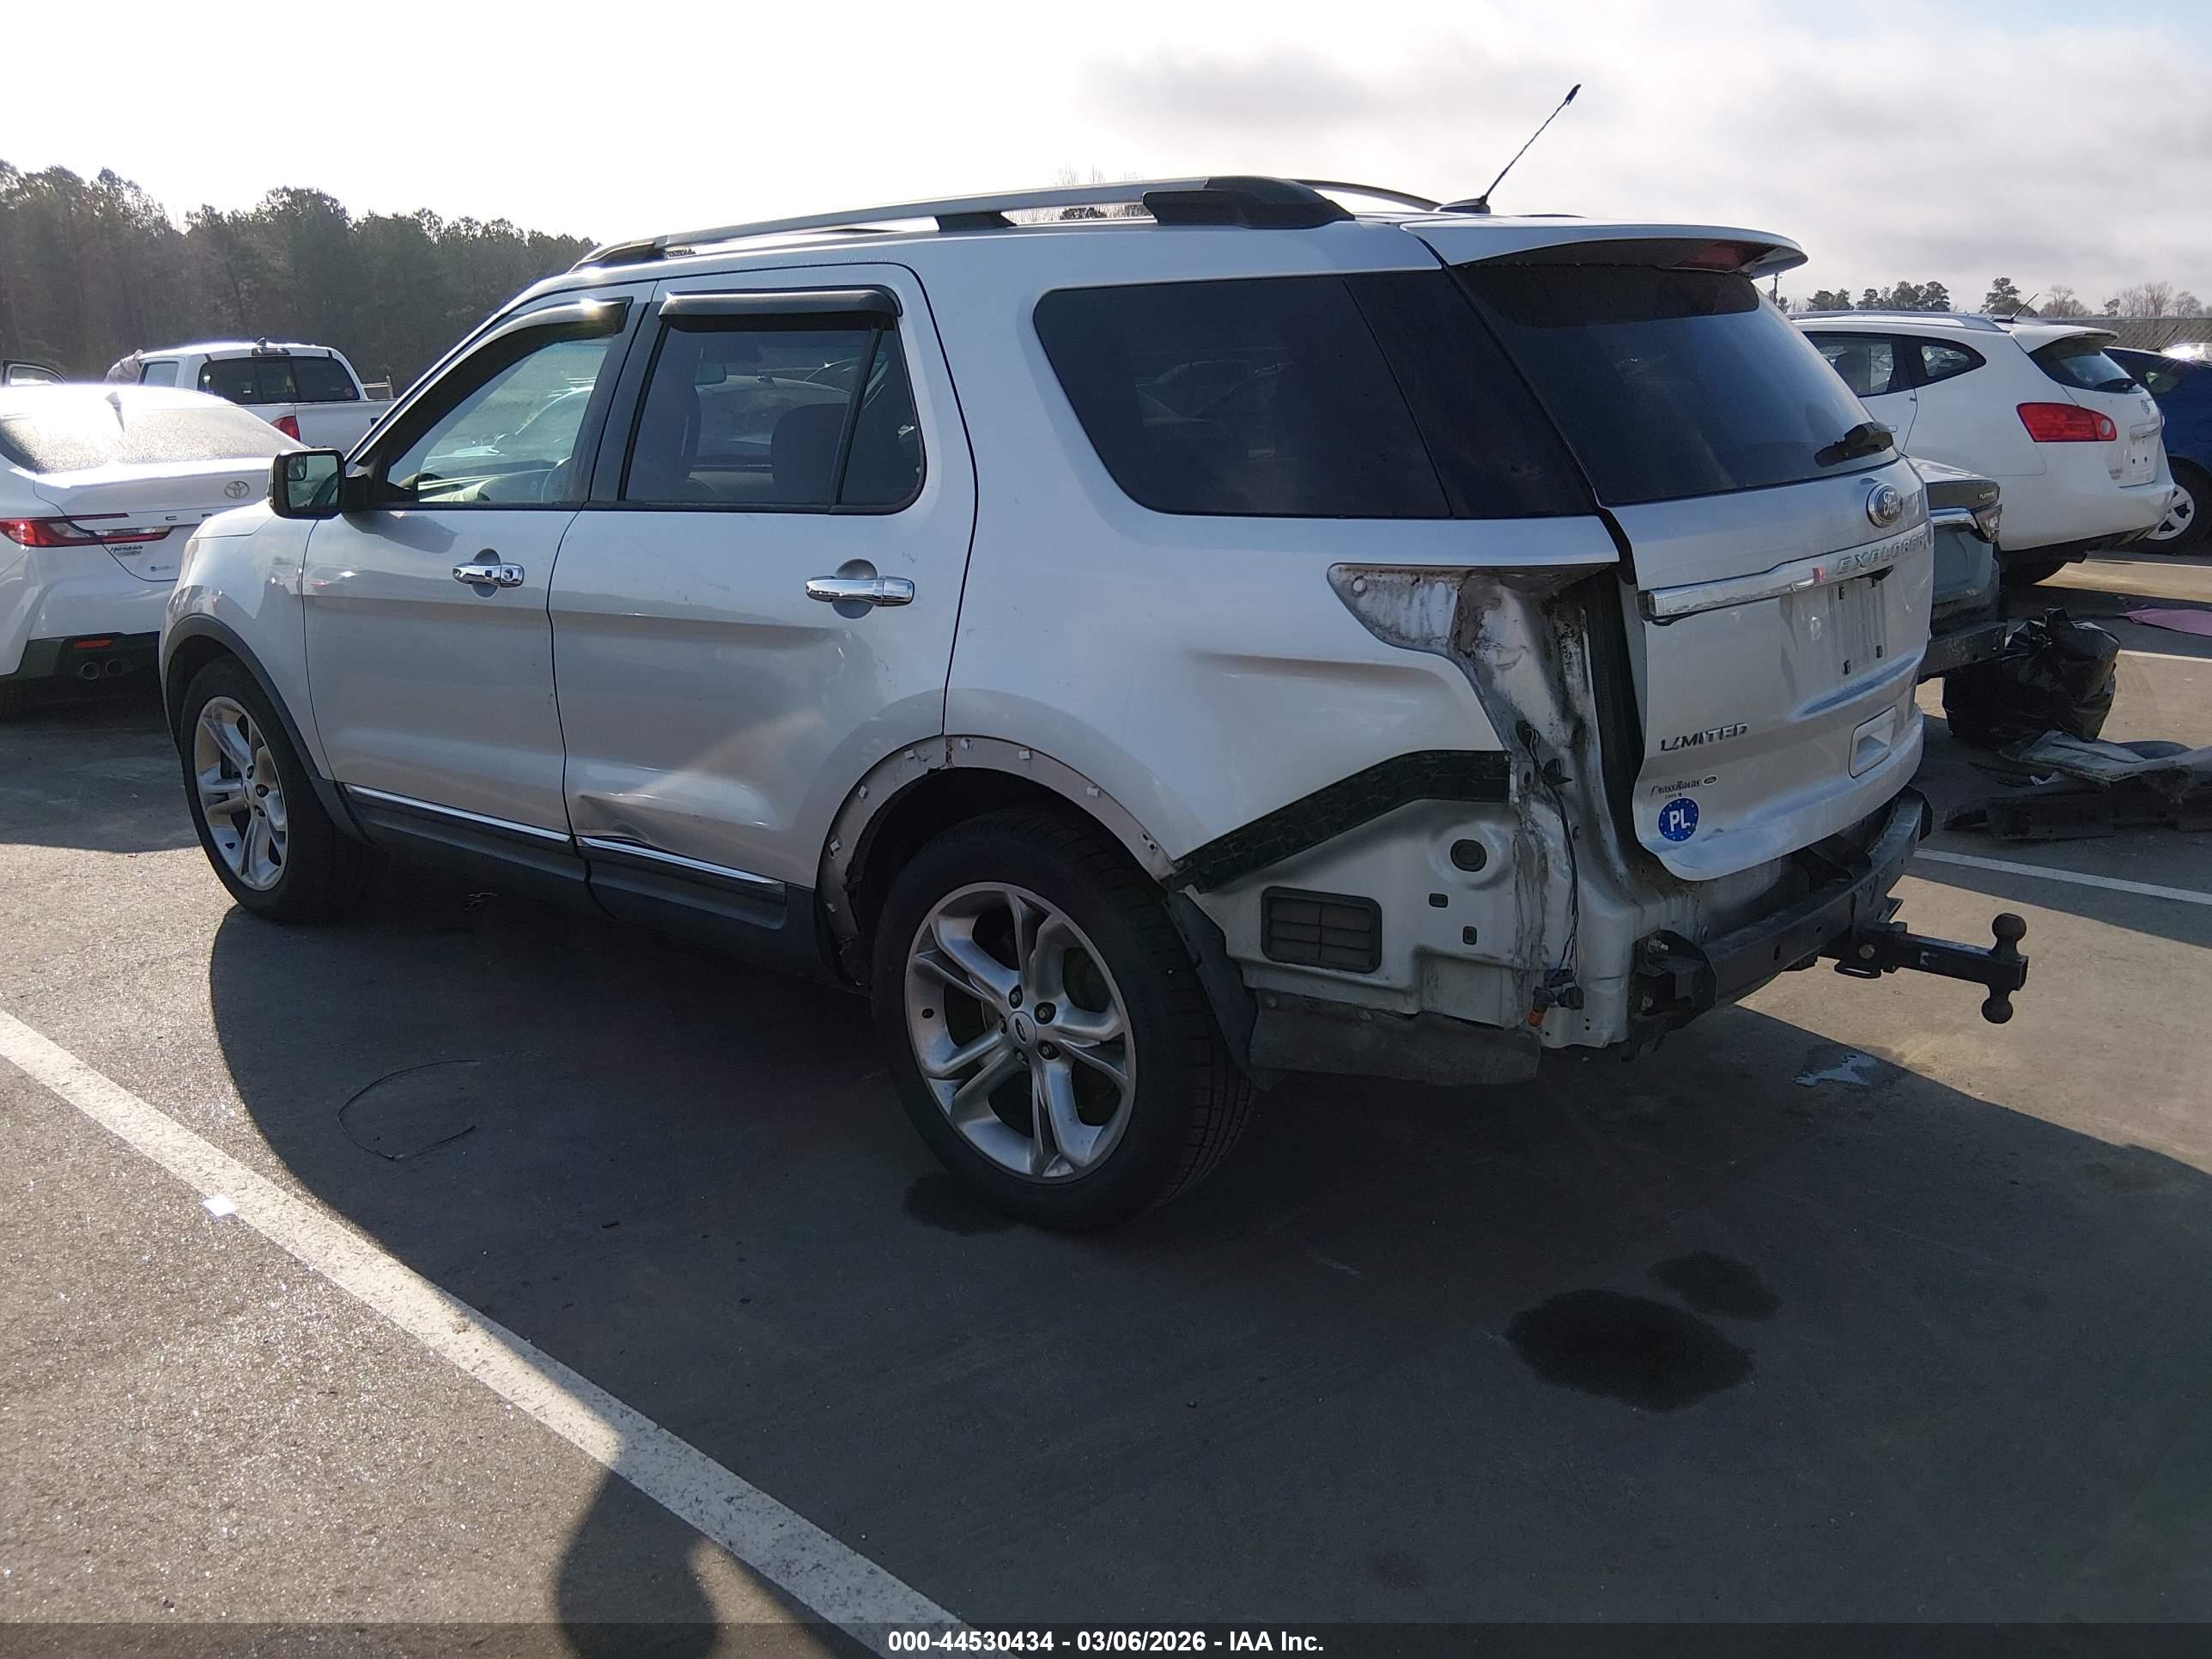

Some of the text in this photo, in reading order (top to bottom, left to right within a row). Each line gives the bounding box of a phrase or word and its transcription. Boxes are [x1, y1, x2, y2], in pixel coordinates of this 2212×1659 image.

[1836, 530, 1929, 574] EXPLORER
[1660, 721, 1749, 752] LIMITED
[1668, 808, 1691, 833] PL
